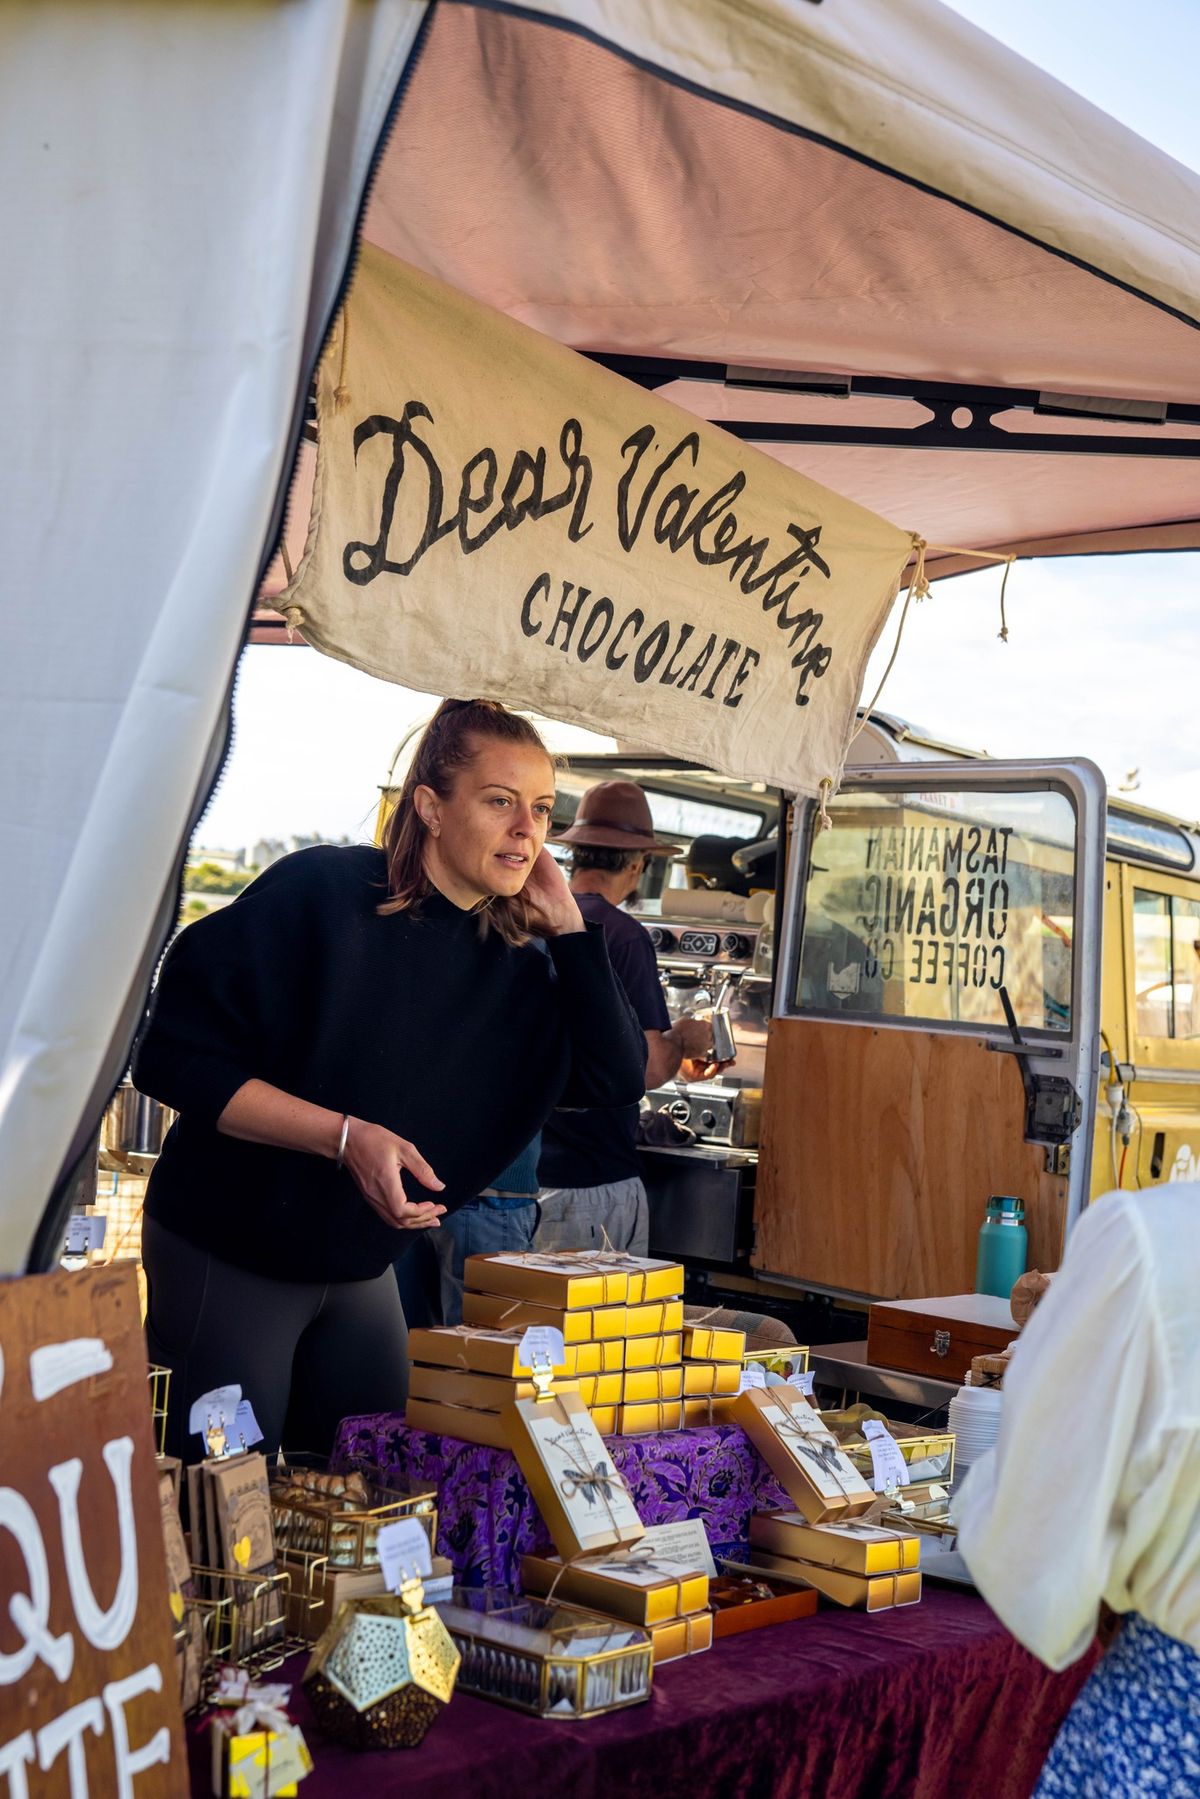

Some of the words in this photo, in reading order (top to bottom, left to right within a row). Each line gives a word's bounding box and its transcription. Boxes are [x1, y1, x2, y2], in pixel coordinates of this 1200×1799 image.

[342, 399, 594, 586] Dear
[617, 424, 833, 707] Valentine
[520, 572, 761, 709] CHOCOLATE
